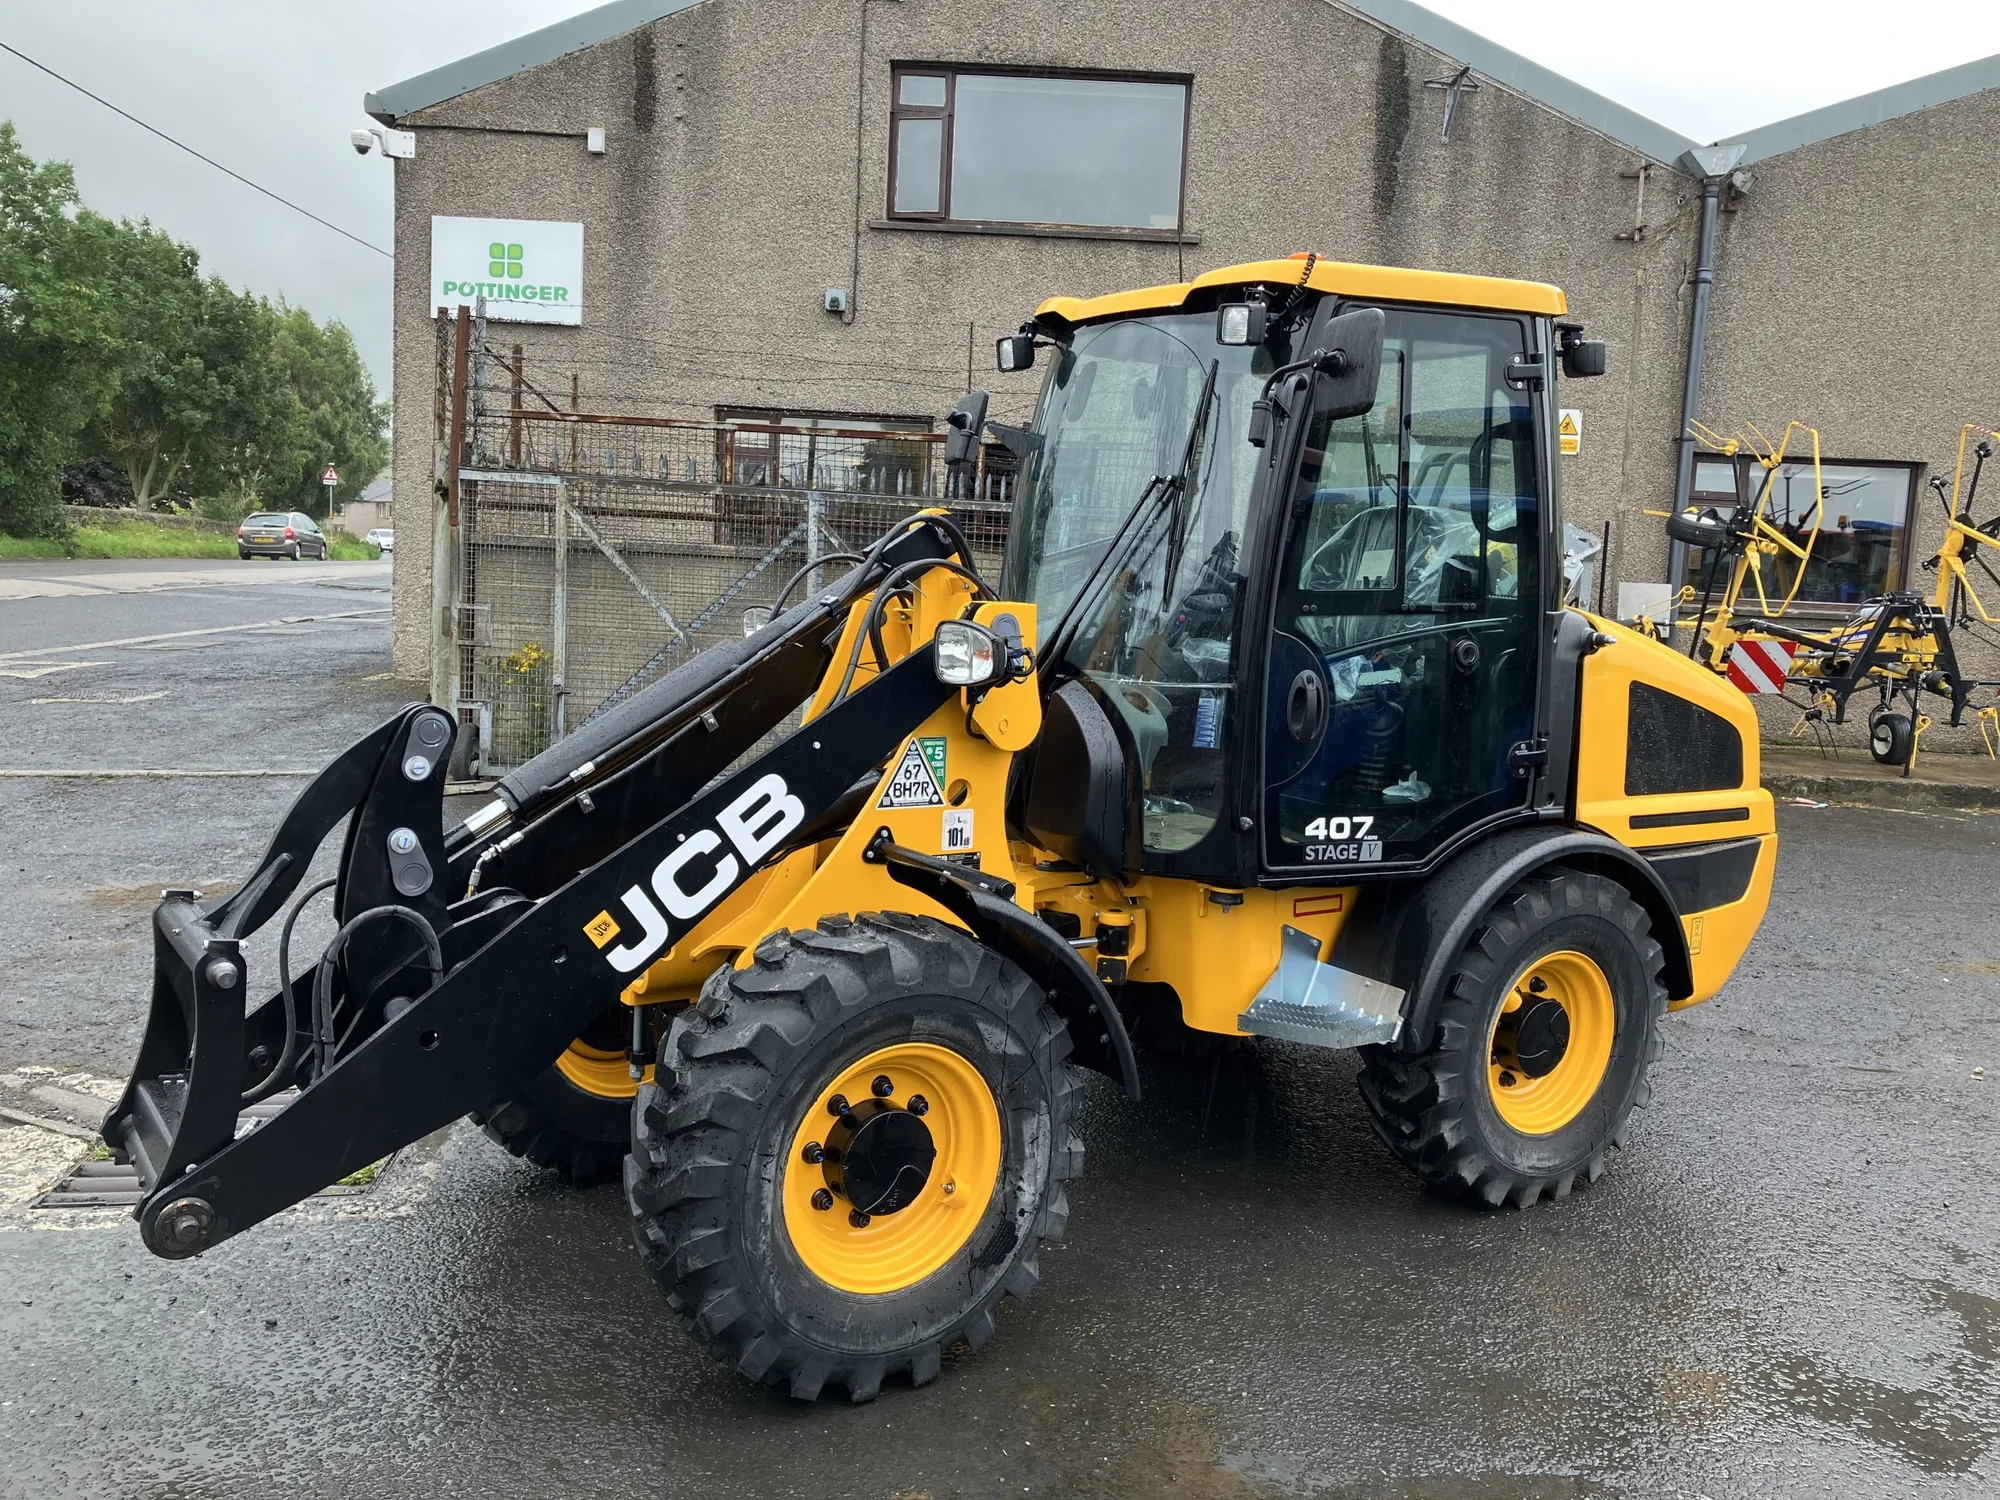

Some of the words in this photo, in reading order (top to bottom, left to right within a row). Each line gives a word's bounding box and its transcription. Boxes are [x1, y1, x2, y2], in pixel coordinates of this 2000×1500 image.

[443, 281, 568, 301] PÖTTINGER
[934, 746, 944, 760] 5
[904, 764, 921, 780] 67
[893, 781, 930, 798] BH7R
[1305, 816, 1374, 840] 407
[947, 827, 964, 847] 101
[1305, 844, 1359, 860] STAGE
[606, 773, 805, 973] JCB
[592, 921, 611, 937] JCB
